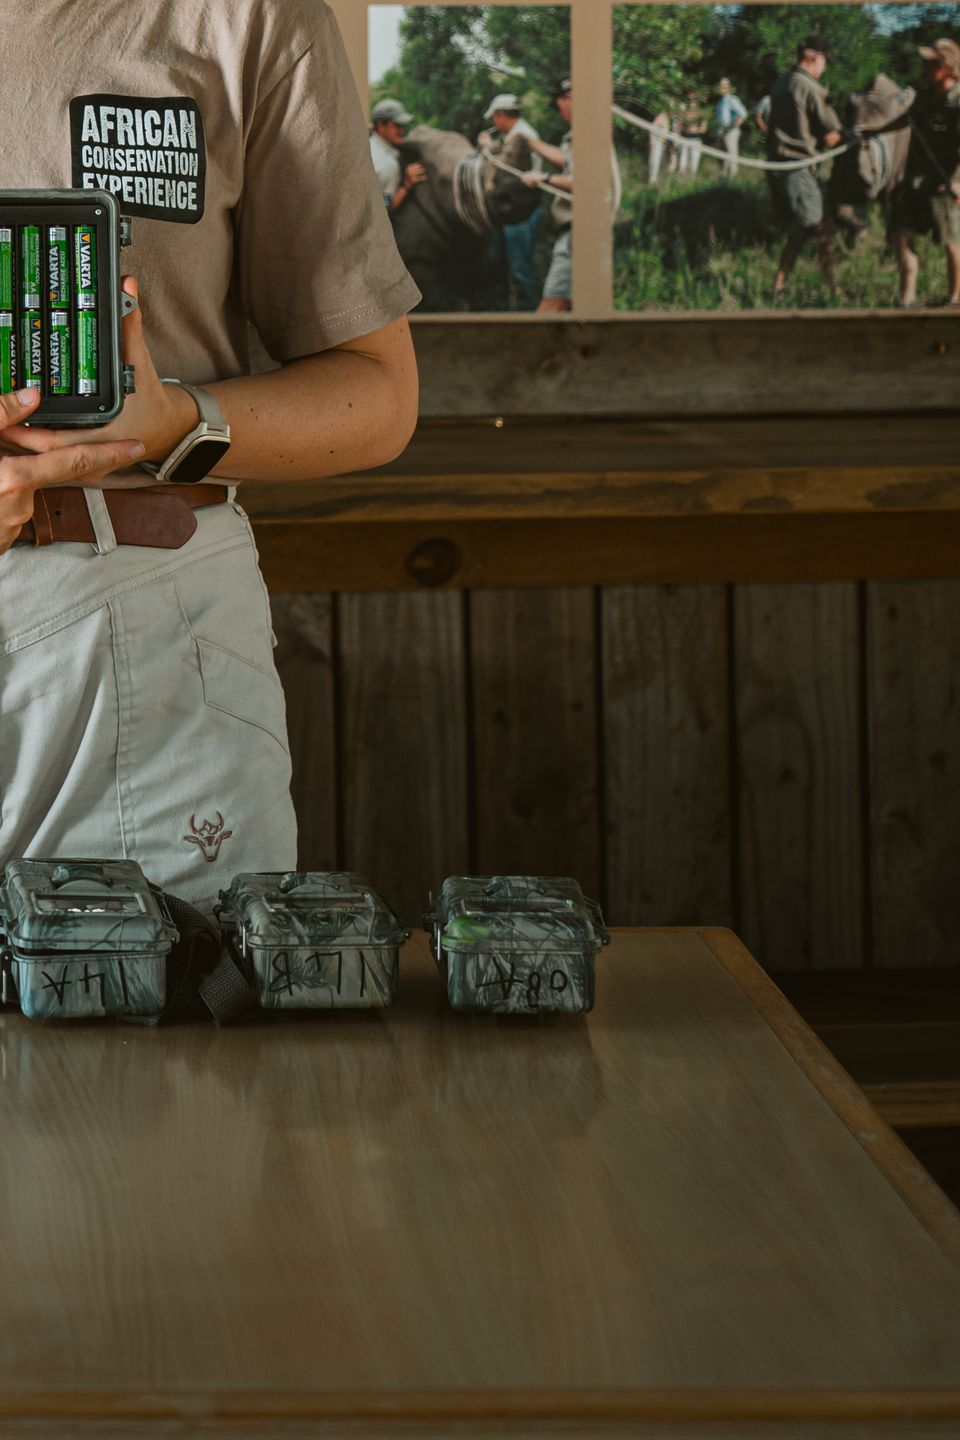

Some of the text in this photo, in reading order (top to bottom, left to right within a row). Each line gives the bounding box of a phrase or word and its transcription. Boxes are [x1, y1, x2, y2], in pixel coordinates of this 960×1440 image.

[81, 105, 197, 149] AFRICAN
[81, 145, 198, 177] CONSERVATION
[82, 172, 198, 211] EXPERIENCE
[49, 246, 59, 290] VARTA
[80, 244, 92, 288] VARTA
[32, 331, 42, 374] VARTA
[50, 331, 60, 375] VARTA
[41, 958, 128, 1008] 14A
